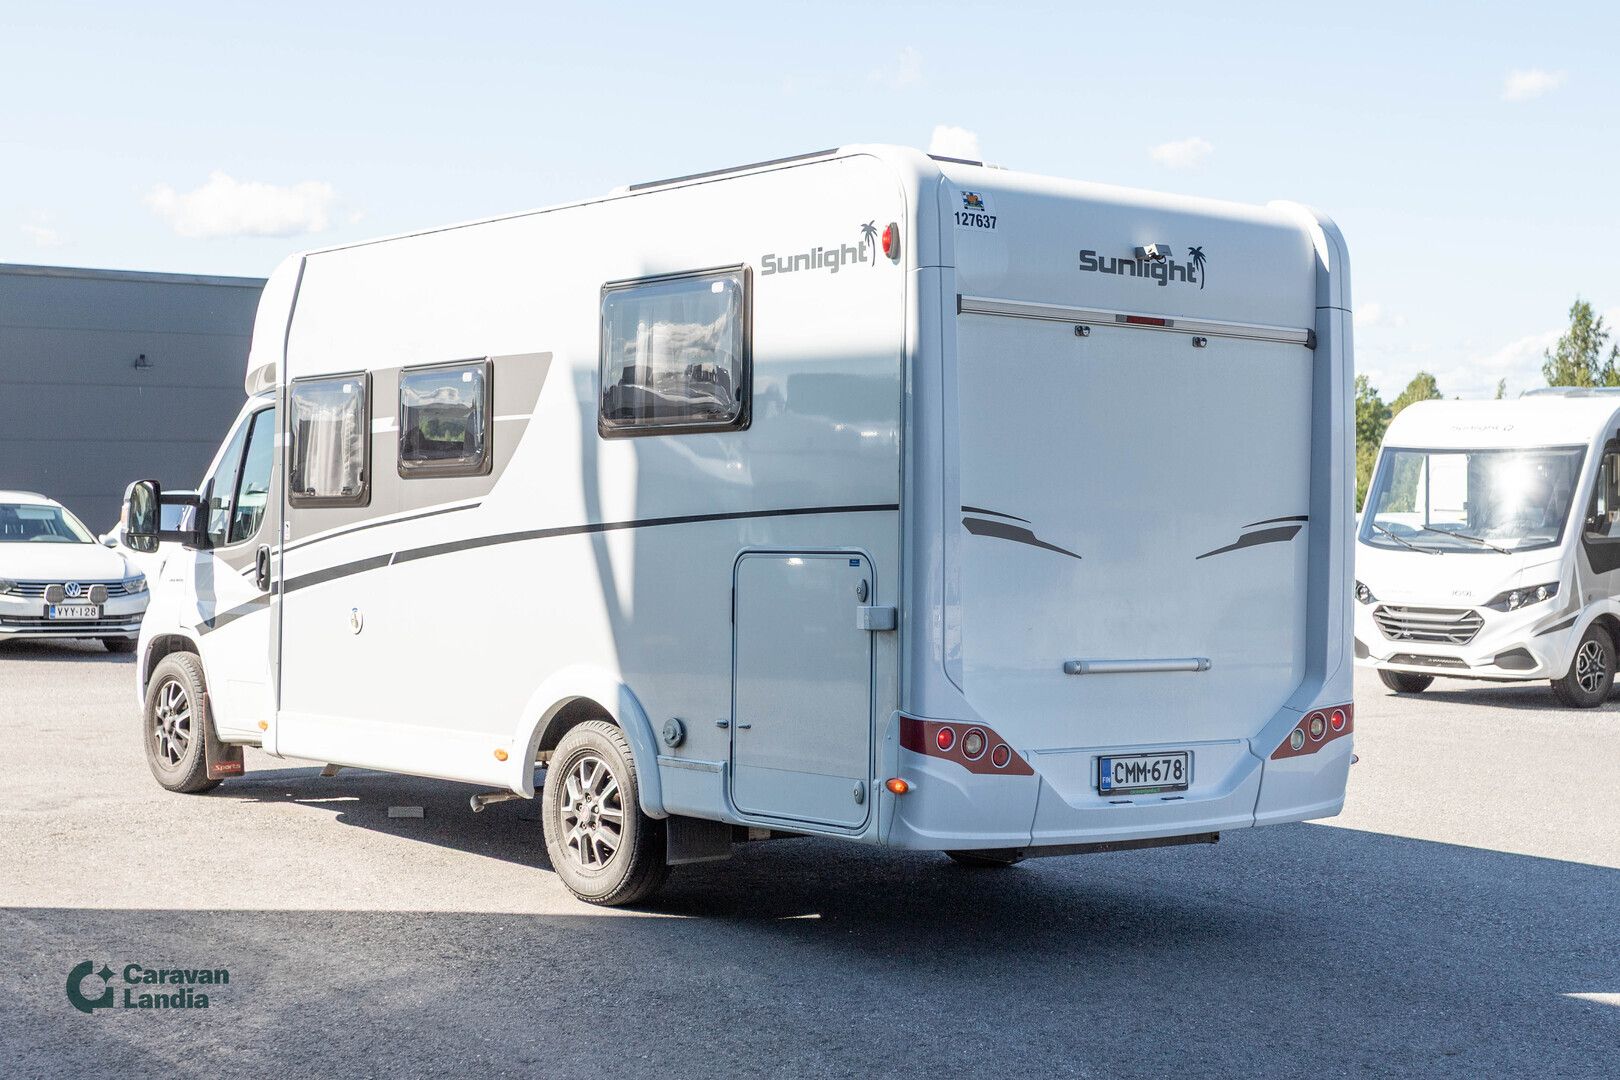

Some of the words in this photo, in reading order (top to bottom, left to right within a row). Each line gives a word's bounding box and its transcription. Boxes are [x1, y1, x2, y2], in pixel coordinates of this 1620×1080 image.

[954, 211, 997, 230] 127637
[761, 240, 868, 276] Sunlight
[1079, 249, 1197, 287] Sunlight
[57, 607, 96, 617] VYY-128
[1114, 759, 1183, 784] CMM-678
